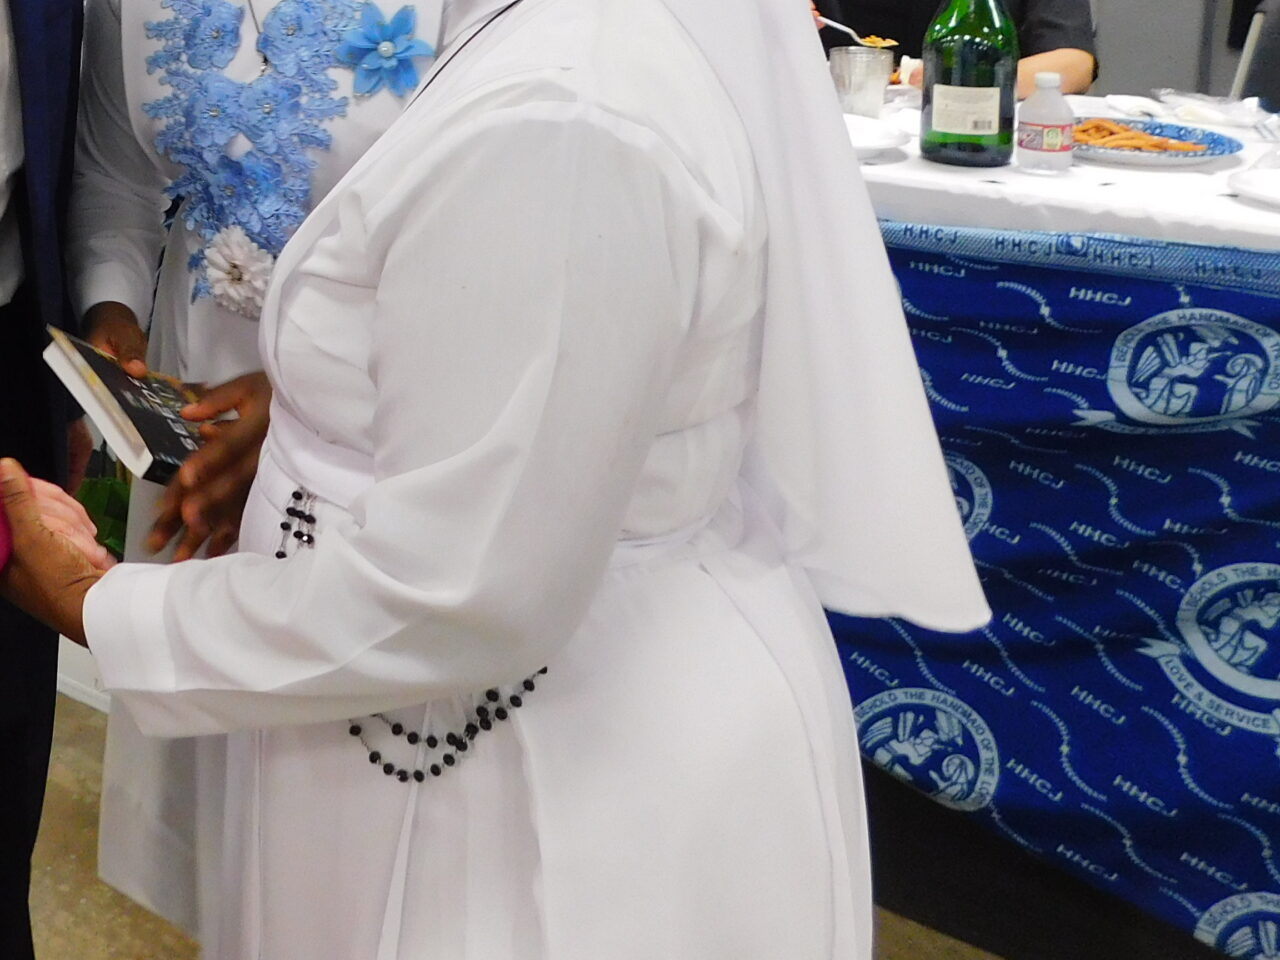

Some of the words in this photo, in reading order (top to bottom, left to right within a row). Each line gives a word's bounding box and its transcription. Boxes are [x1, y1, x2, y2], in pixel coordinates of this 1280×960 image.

[903, 224, 959, 243] HHCJ
[995, 237, 1053, 256] HHCJ
[910, 260, 966, 278] HHCJ
[1069, 286, 1132, 306] HHCJ
[912, 328, 953, 343] HCJ
[960, 373, 1017, 390] HHCJ
[1051, 359, 1108, 381] HHCJ
[1008, 460, 1066, 489] HHCJ
[1113, 455, 1173, 484] HHCJ
[1233, 451, 1280, 473] HHC
[982, 521, 1021, 545] HCJ
[1069, 521, 1131, 549] HHCJ
[1132, 559, 1185, 593] HHC
[1002, 612, 1056, 646] HHCJ
[850, 651, 900, 687] HHCJ
[962, 659, 1016, 696] HHCJ
[904, 691, 926, 701] THE
[1070, 685, 1127, 725] HHCJ
[1165, 658, 1194, 690] LOVE
[1207, 699, 1270, 729] SERVICE
[1006, 758, 1064, 802] HHCJ
[1112, 774, 1179, 817] HHCJ
[1240, 792, 1280, 814] HH
[1056, 843, 1118, 881] HHCJ
[1179, 851, 1248, 890] HHCJ
